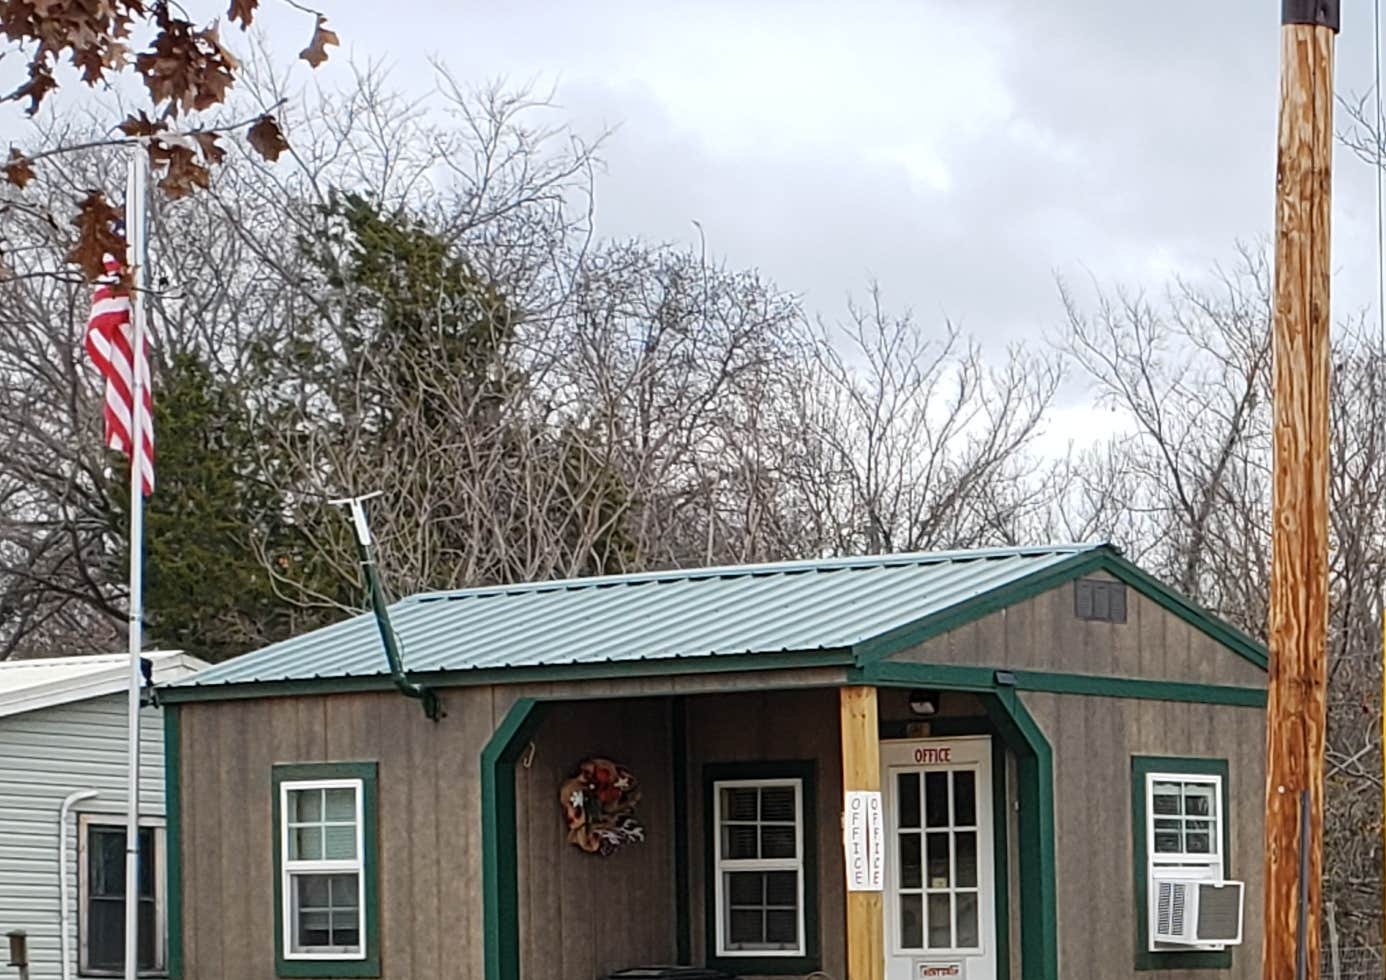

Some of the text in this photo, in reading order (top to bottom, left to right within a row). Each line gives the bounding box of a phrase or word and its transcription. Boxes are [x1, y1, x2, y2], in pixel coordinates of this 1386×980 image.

[915, 748, 951, 762] OFFICE
[851, 798, 863, 885] OFFICE
[871, 798, 880, 885] OFFICE
